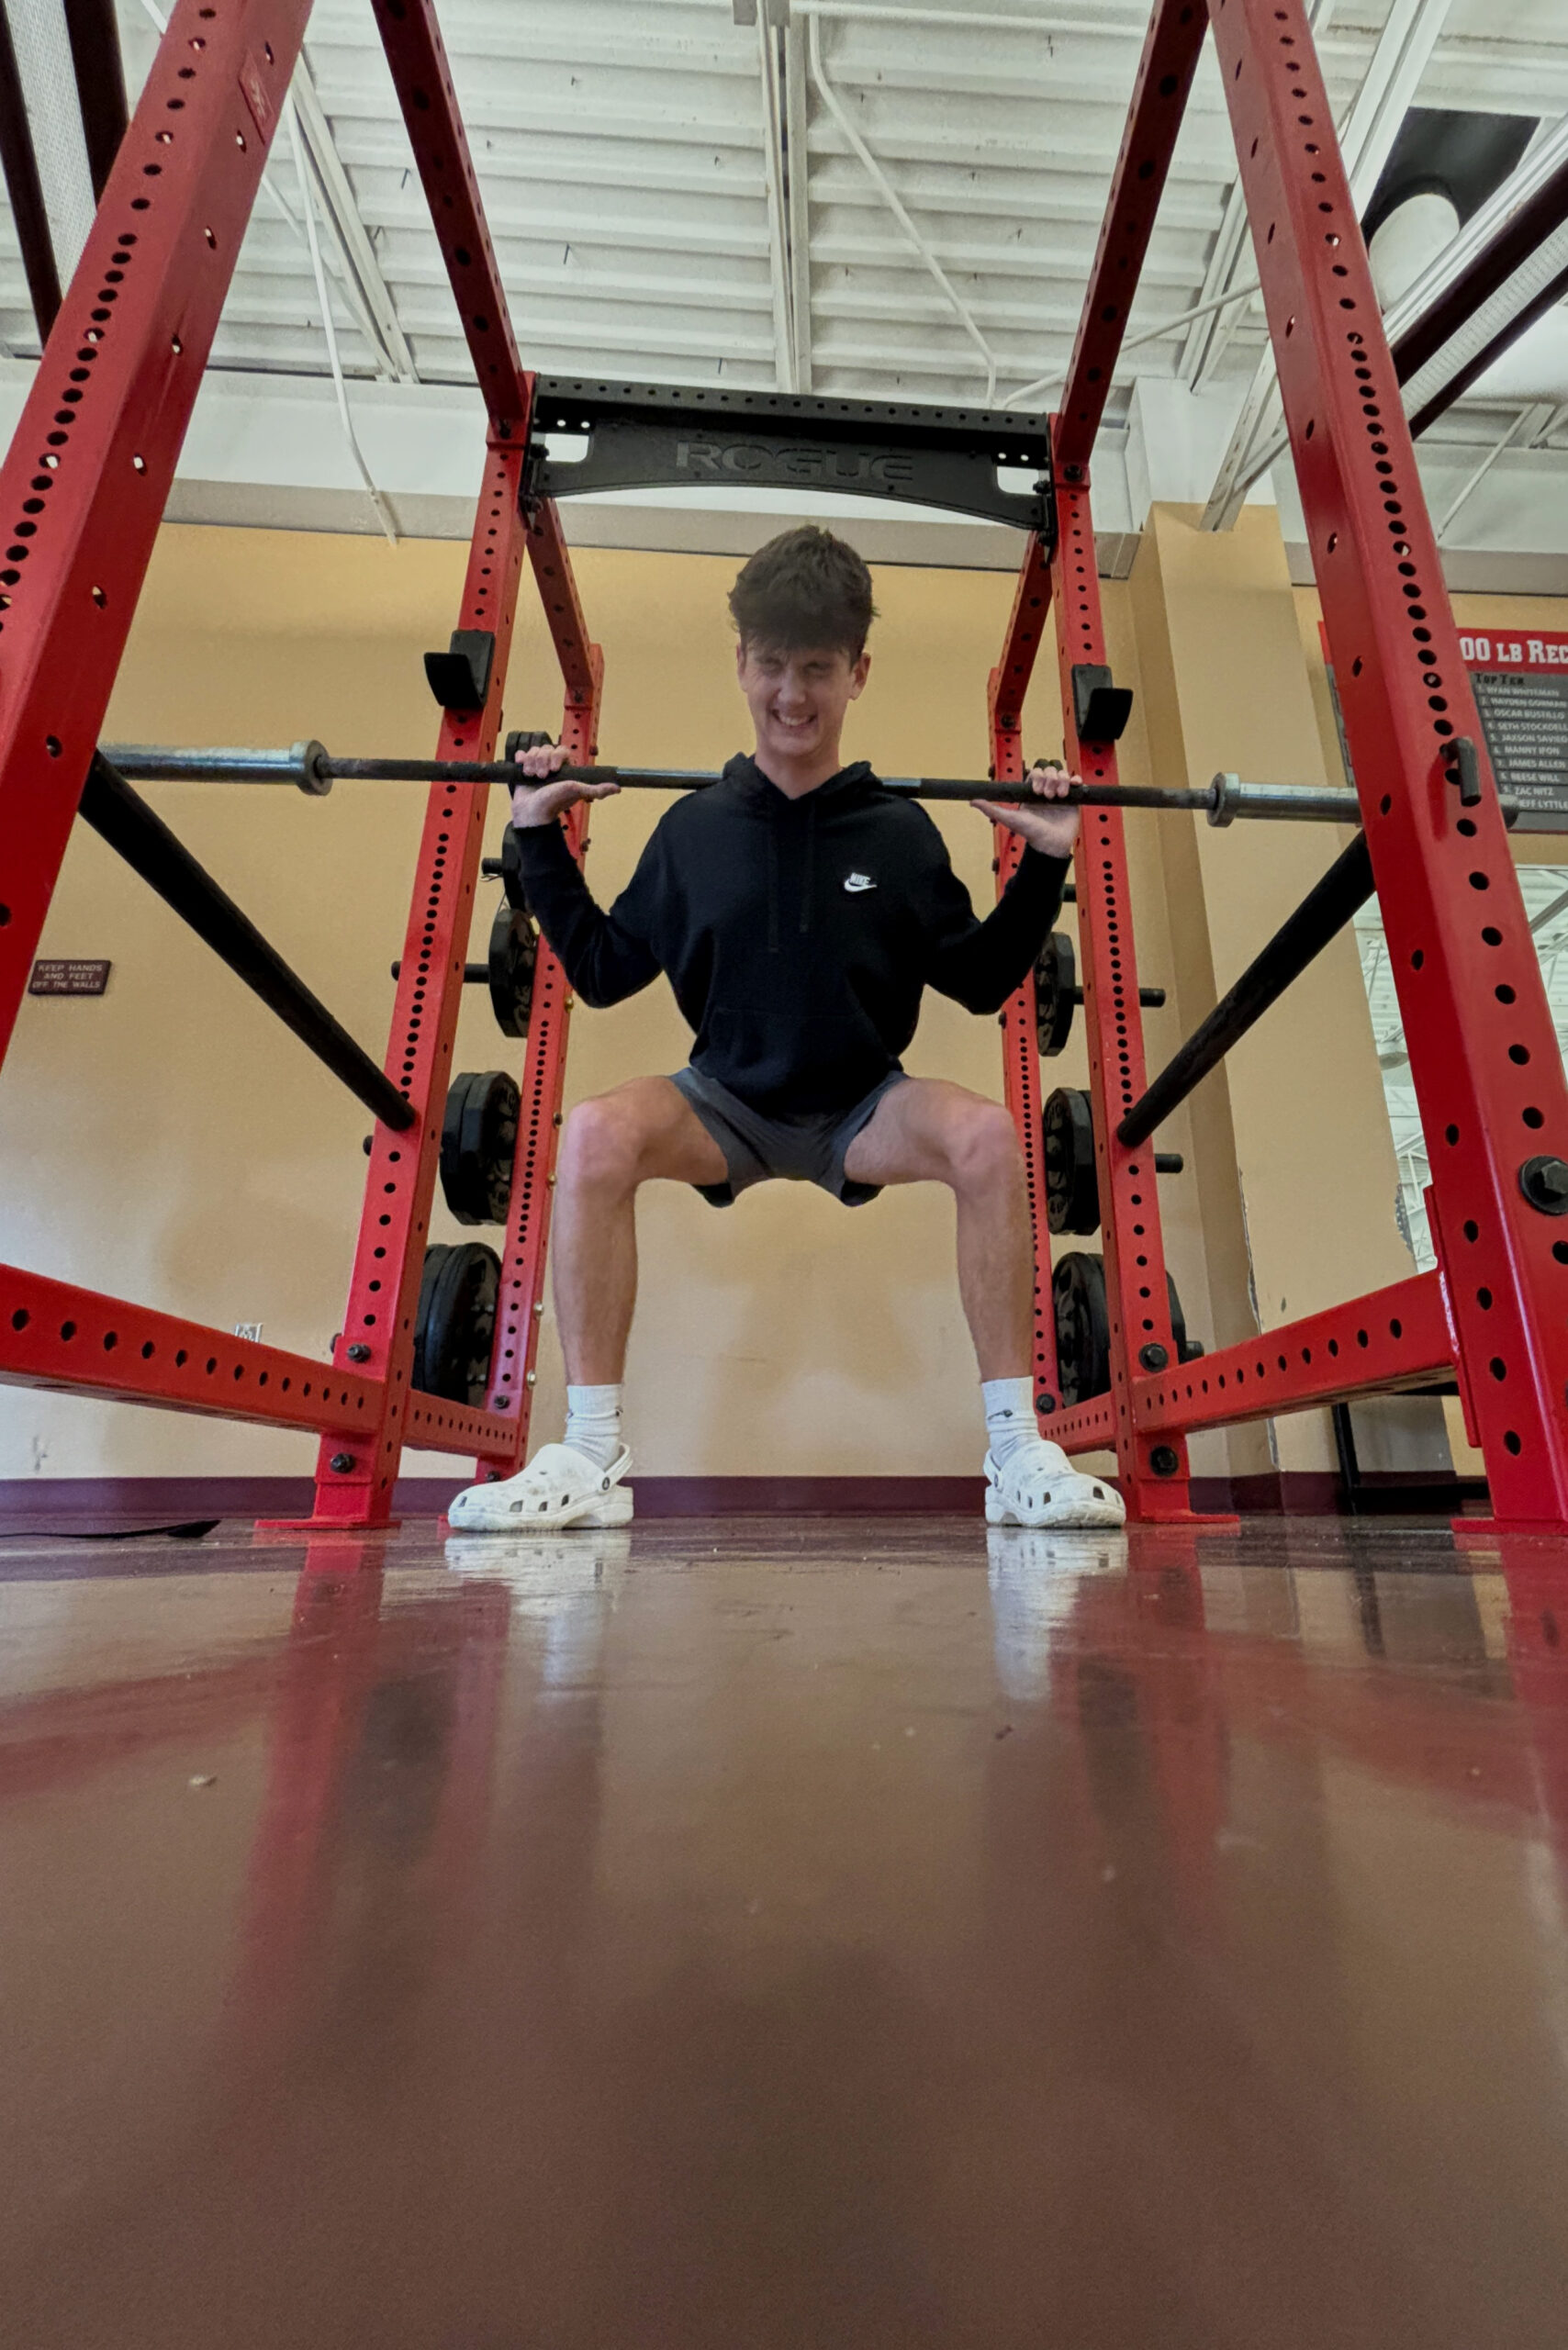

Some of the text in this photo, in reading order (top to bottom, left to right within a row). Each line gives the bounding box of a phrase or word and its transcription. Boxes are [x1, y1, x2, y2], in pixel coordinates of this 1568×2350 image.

[676, 440, 914, 482] ROGUE
[1494, 708, 1523, 718] OSCAR
[1497, 722, 1519, 731] SETH
[1508, 758, 1537, 768] JAMES
[1539, 759, 1566, 769] ALLEN
[1515, 787, 1532, 796] ZAC
[38, 964, 103, 972] KEEP HANDS
[43, 972, 94, 980] AND FEET
[32, 980, 101, 989] OFF THE WALLS
